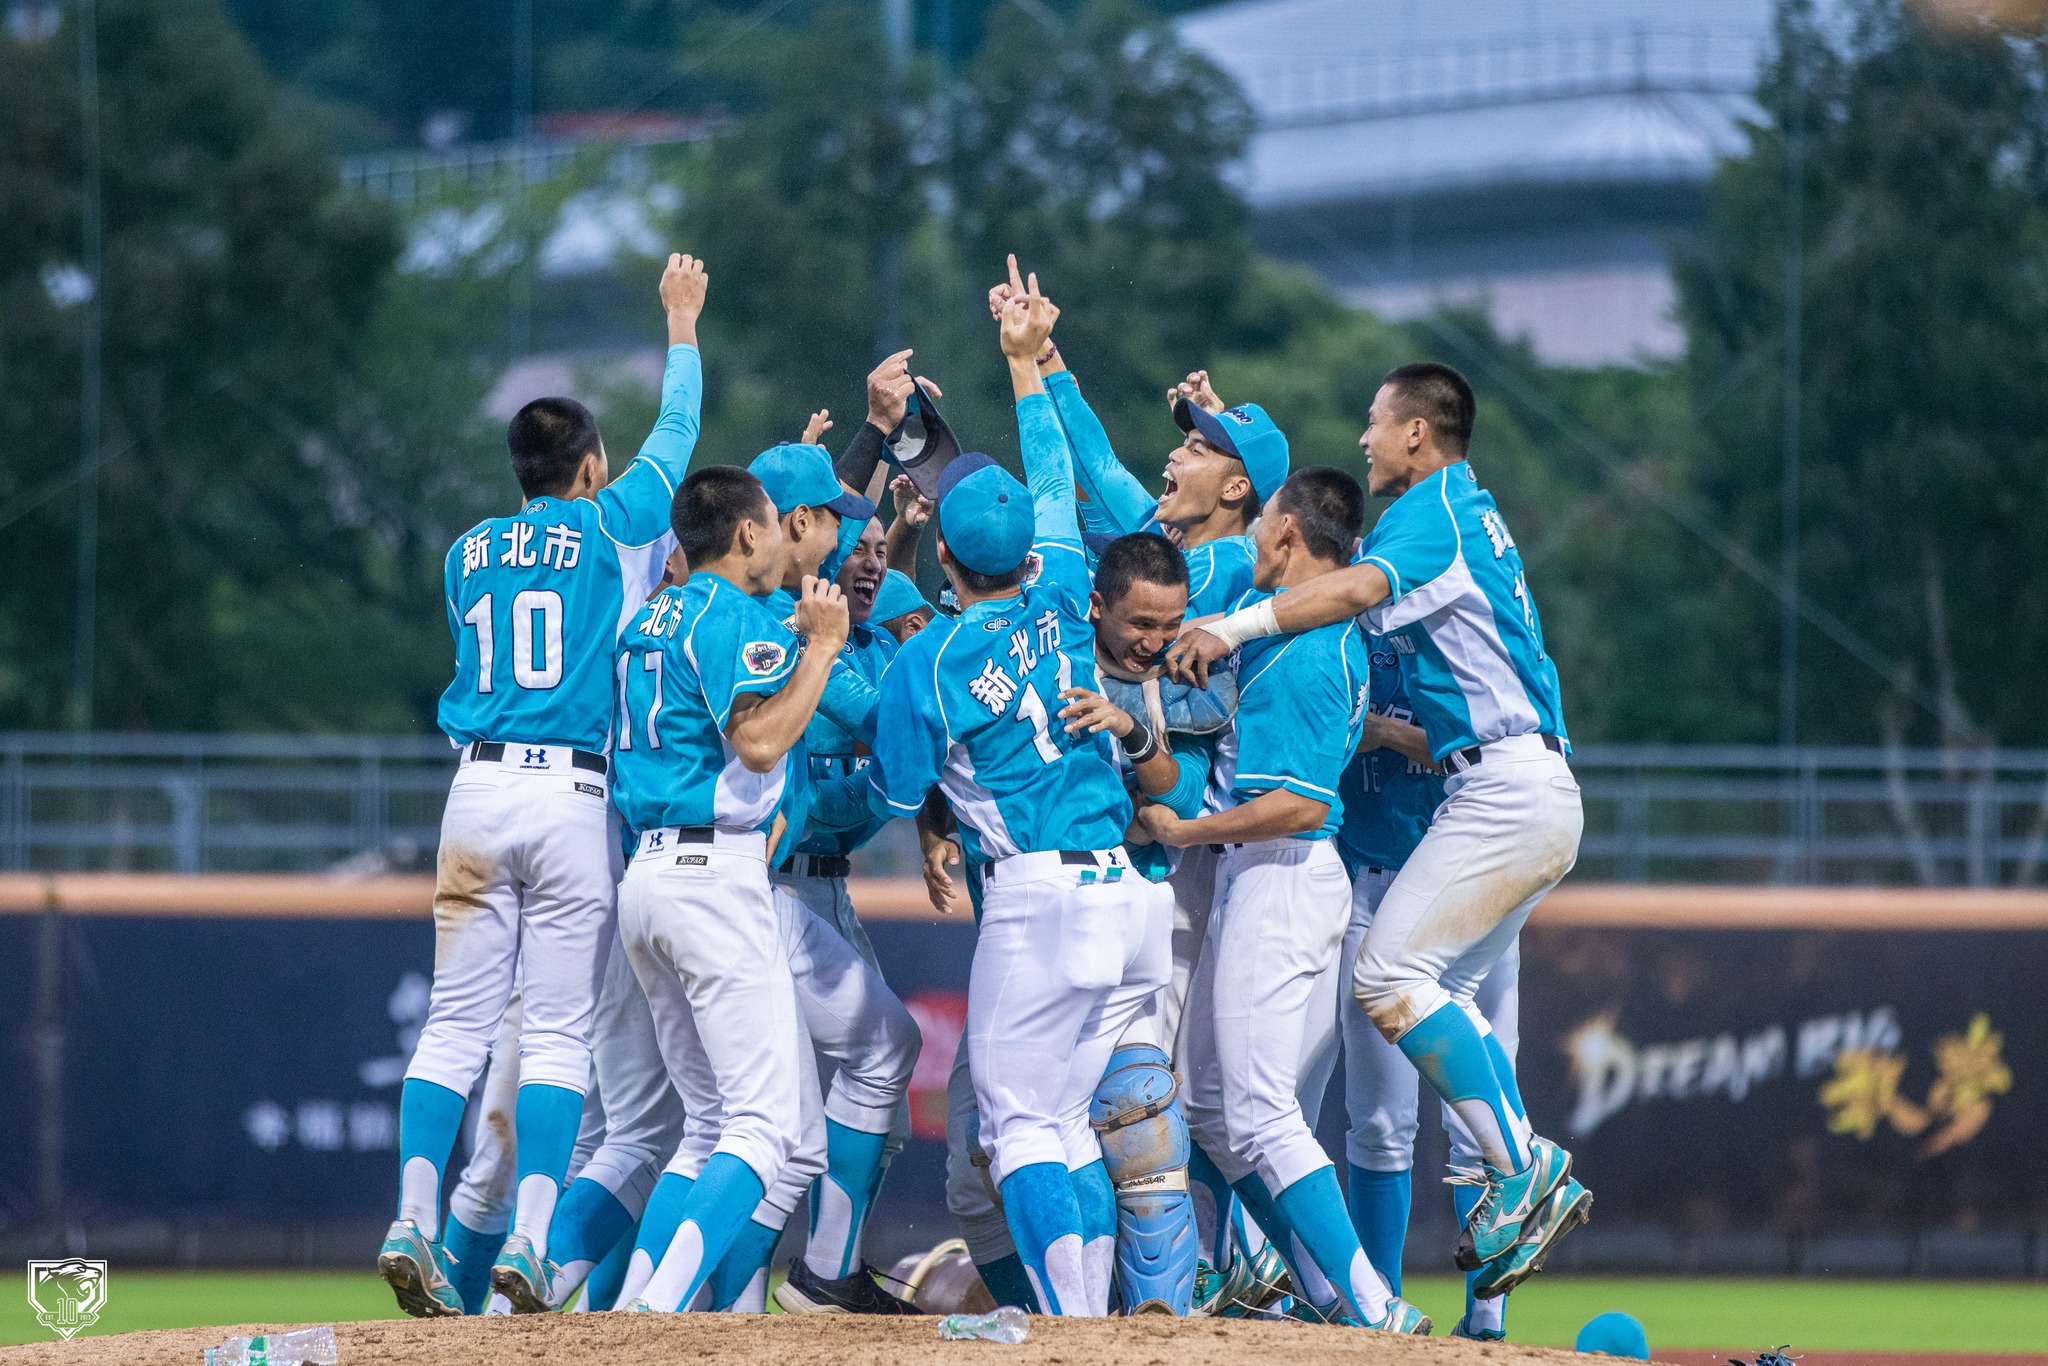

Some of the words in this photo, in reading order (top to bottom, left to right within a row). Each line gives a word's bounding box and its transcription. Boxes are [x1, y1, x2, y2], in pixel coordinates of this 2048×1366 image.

[462, 521, 582, 581] 新北市
[463, 589, 564, 695] 10
[968, 609, 1062, 717] 新北市
[615, 649, 664, 751] 17
